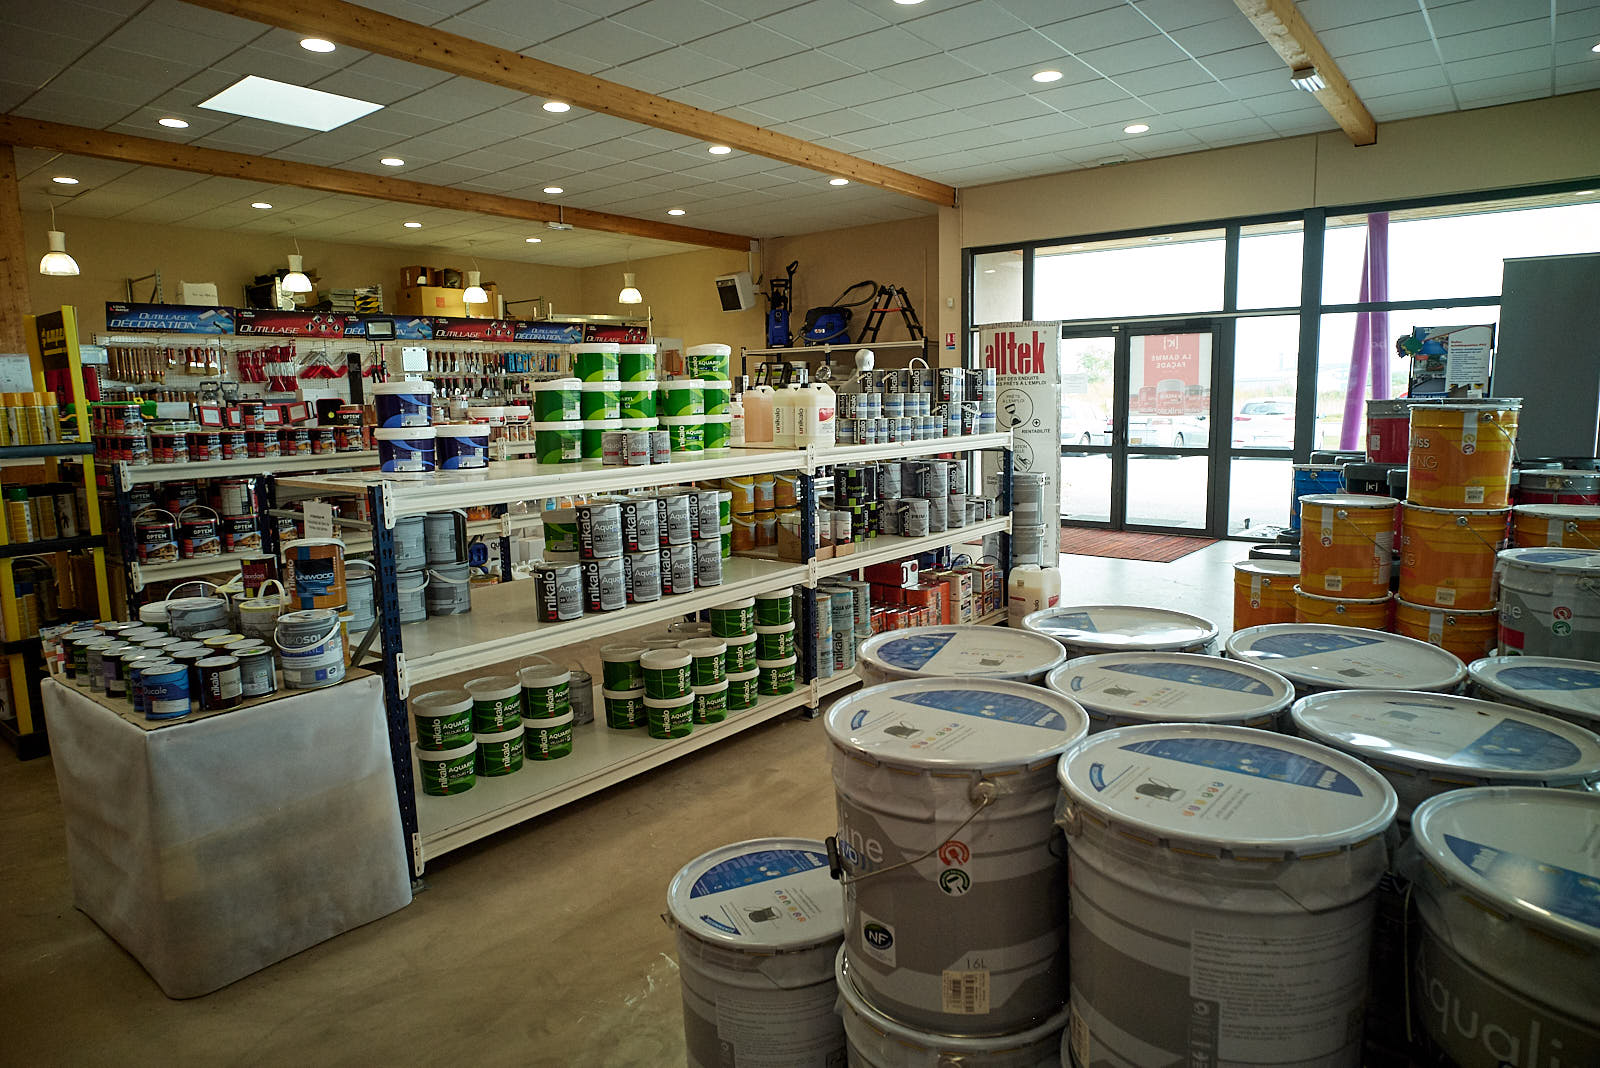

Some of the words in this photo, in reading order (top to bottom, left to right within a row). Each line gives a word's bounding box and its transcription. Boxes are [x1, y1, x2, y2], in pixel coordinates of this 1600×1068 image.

[110, 319, 198, 330] DÉCORATION
[239, 325, 300, 334] OUTILLAGE
[986, 331, 1045, 375] alltek
[581, 510, 592, 557] unikalo
[625, 505, 638, 550] unikalo
[658, 500, 668, 544] unikalo
[689, 496, 699, 538] unikalo
[587, 563, 600, 610] unikalo
[661, 550, 672, 593] unikalo
[543, 571, 558, 620] unikalo
[833, 632, 844, 670] unikalo
